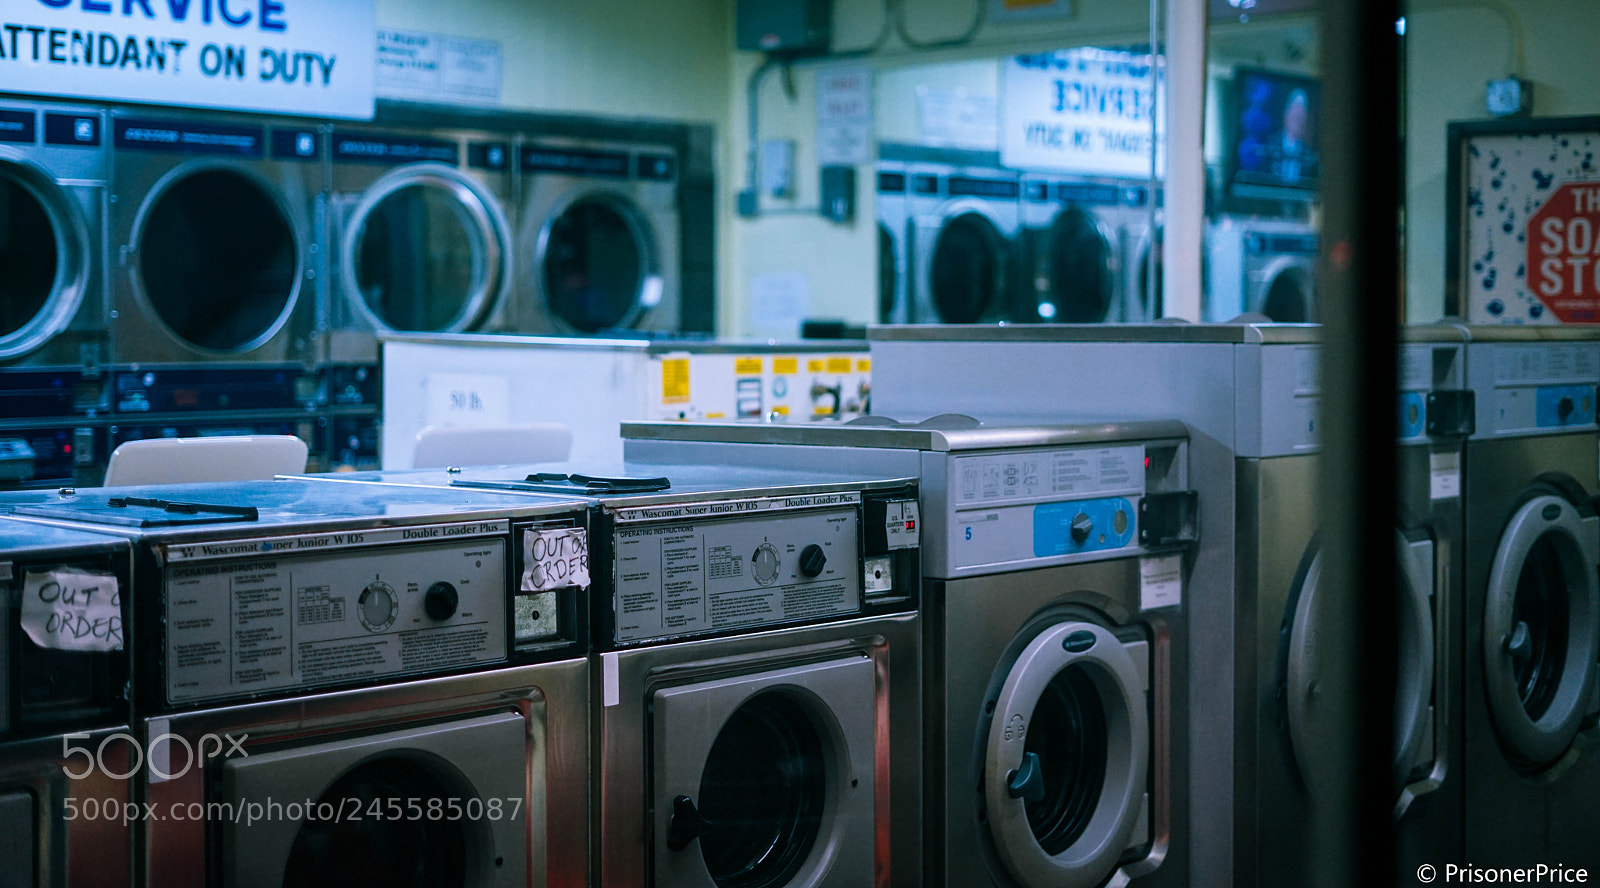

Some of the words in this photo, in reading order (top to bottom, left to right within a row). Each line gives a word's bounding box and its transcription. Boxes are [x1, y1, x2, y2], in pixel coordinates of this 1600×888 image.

[37, 0, 287, 31] VICE
[0, 24, 187, 73] TTENDANT
[200, 44, 245, 78] ON
[260, 48, 335, 85] DUTY
[1540, 257, 1600, 296] ST
[641, 508, 682, 518] Wascomat
[710, 504, 733, 513] Junior
[785, 497, 811, 508] Double
[813, 496, 837, 505] Loader
[839, 495, 853, 503] Plus
[402, 527, 439, 539] Double
[443, 525, 477, 536] Loader
[479, 523, 498, 533] Plus
[620, 529, 653, 538] OPERATING
[653, 526, 694, 536] INSTRUCTIONS
[965, 526, 972, 541] 5
[202, 544, 258, 556] Wascomat
[297, 537, 329, 548] Junior
[532, 535, 571, 562] OUT
[173, 567, 218, 577] OPERATING
[221, 562, 277, 573] INSTRUCTIONS
[531, 555, 588, 588] ORDER
[38, 581, 99, 606] OUT
[45, 611, 123, 643] ORDER
